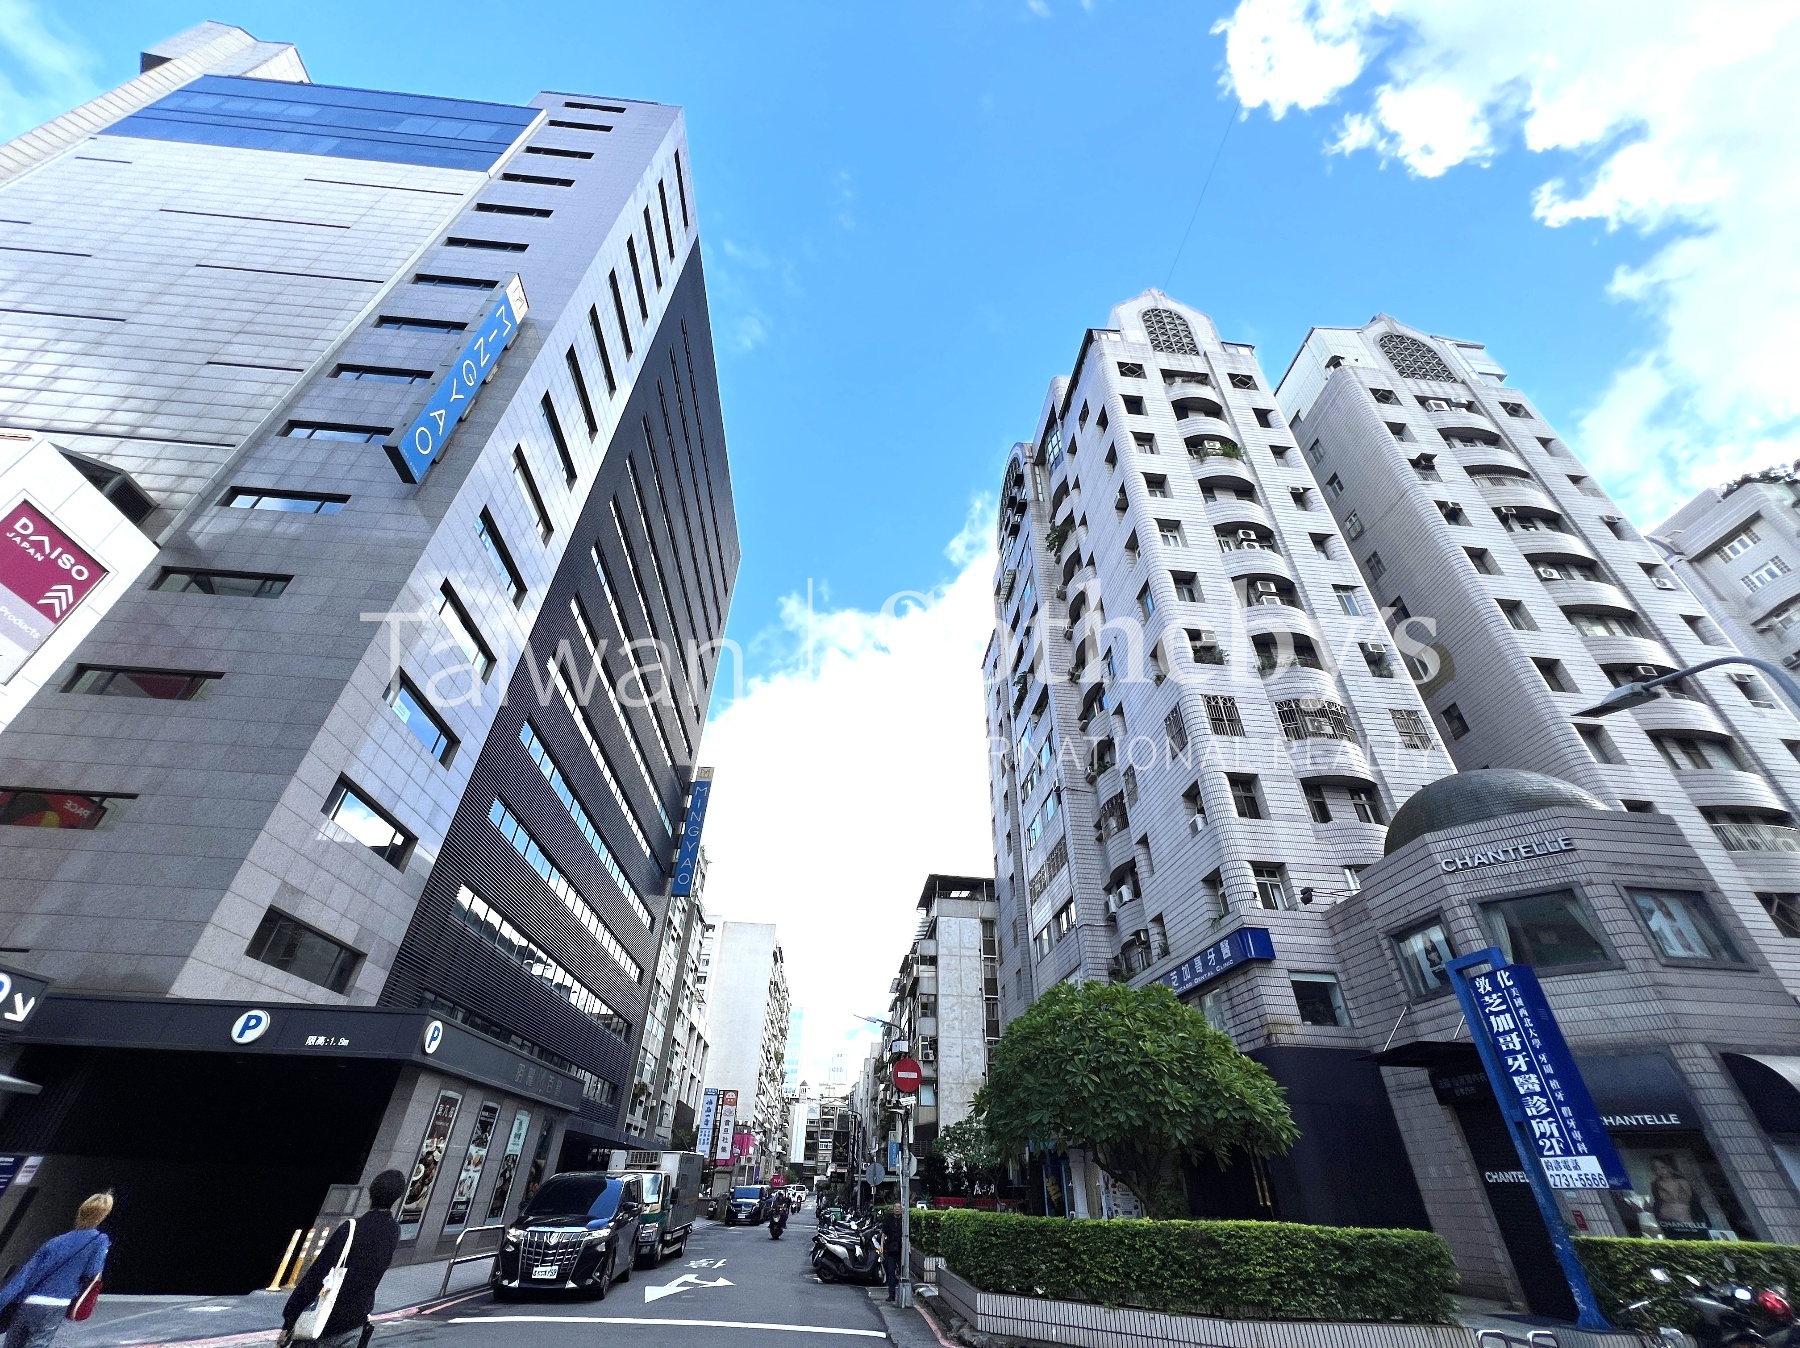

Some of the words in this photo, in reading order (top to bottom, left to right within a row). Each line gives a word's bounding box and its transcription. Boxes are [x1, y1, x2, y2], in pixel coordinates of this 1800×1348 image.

[414, 304, 512, 455] MINGYAO
[6, 531, 45, 562] JAPAN
[14, 516, 89, 581] DAISO
[677, 786, 708, 884] MINGYAO
[1441, 836, 1574, 872] CHANTELLE
[237, 1015, 263, 1038] P
[427, 1025, 441, 1049] P
[1549, 1173, 1608, 1188] 2731-5566
